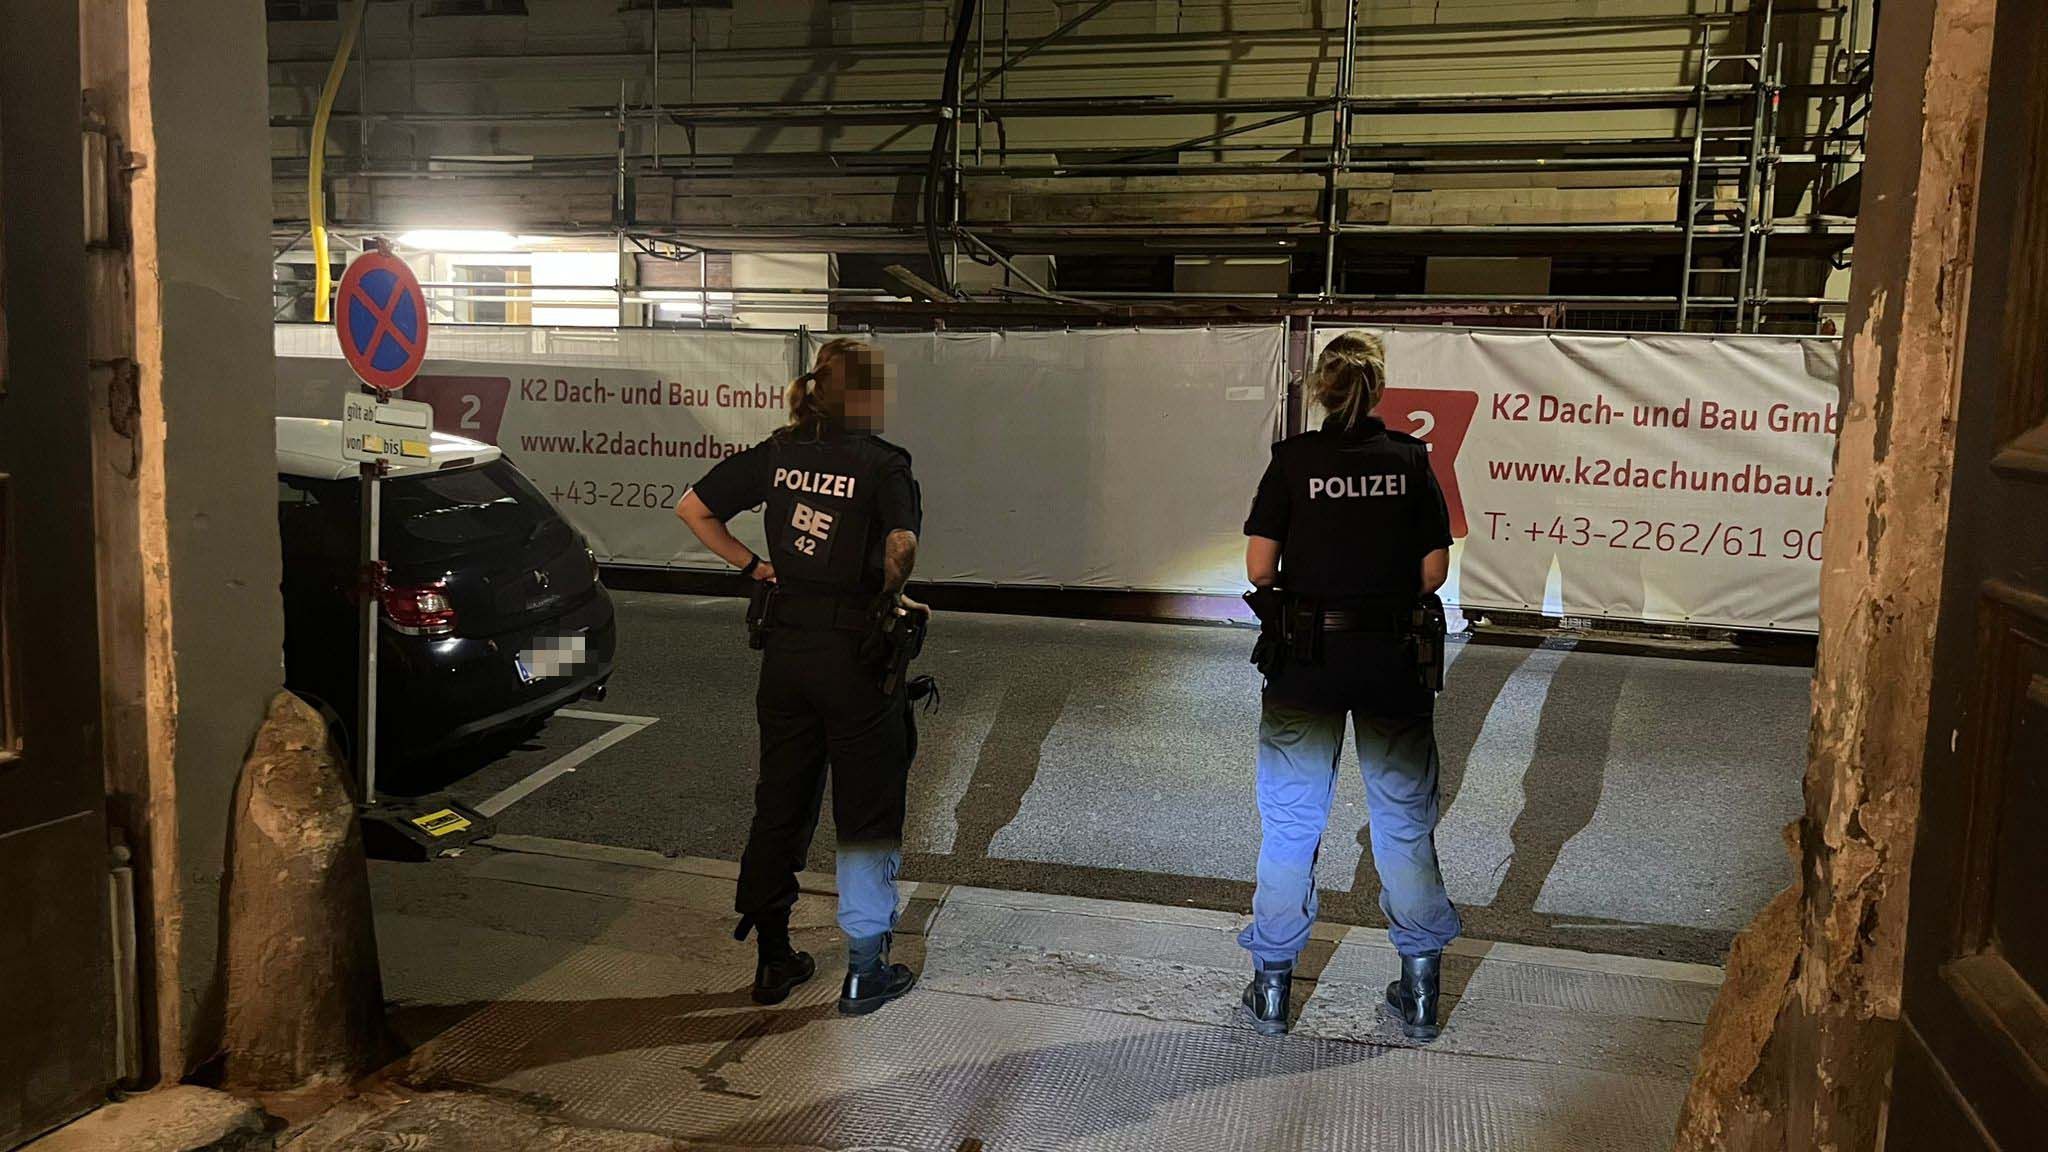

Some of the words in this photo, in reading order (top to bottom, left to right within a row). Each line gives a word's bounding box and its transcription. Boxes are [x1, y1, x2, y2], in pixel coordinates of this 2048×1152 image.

[521, 378, 548, 401] K2
[554, 378, 615, 404] Dach-
[622, 380, 662, 405] und
[669, 382, 709, 407] Bau
[717, 382, 785, 409] GmbH
[347, 403, 362, 421] gilt
[364, 406, 374, 421] ab
[461, 395, 481, 430] 2
[1491, 393, 1530, 421] K2
[1539, 394, 1624, 425] Dach-
[1633, 398, 1690, 428] und
[1700, 401, 1757, 431] Bau
[346, 437, 360, 450] von
[384, 439, 399, 454] bis
[774, 467, 856, 499] POLIZEI
[1309, 474, 1406, 500] POLIZEI
[791, 502, 833, 540] BE
[1484, 511, 1511, 541] T:
[1524, 516, 1767, 558] +43-2262/61
[794, 535, 816, 556] 42
